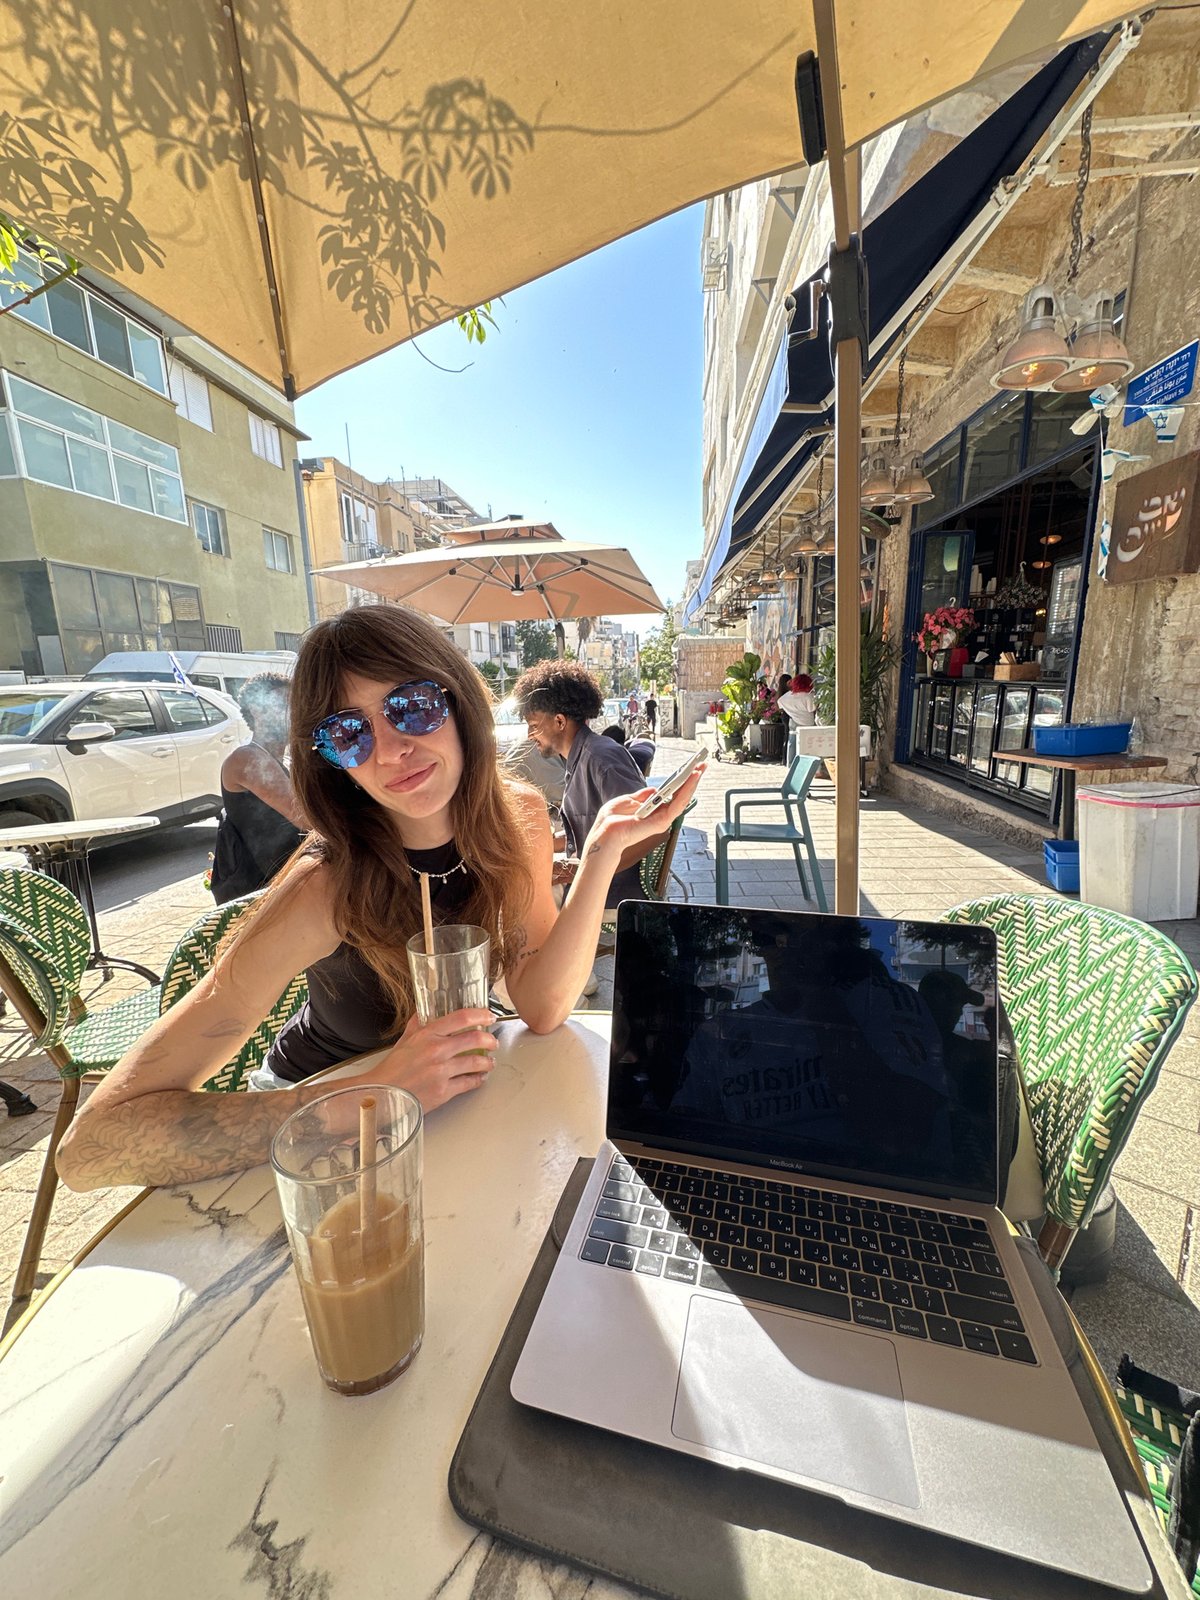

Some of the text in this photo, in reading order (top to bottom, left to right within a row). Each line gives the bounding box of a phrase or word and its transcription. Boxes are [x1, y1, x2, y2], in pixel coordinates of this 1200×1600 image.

[770, 1159, 794, 1168] MacBook
[668, 1271, 694, 1280] command
[858, 1314, 887, 1325] command
[1003, 1318, 1018, 1327] shift
[900, 1324, 920, 1332] option
